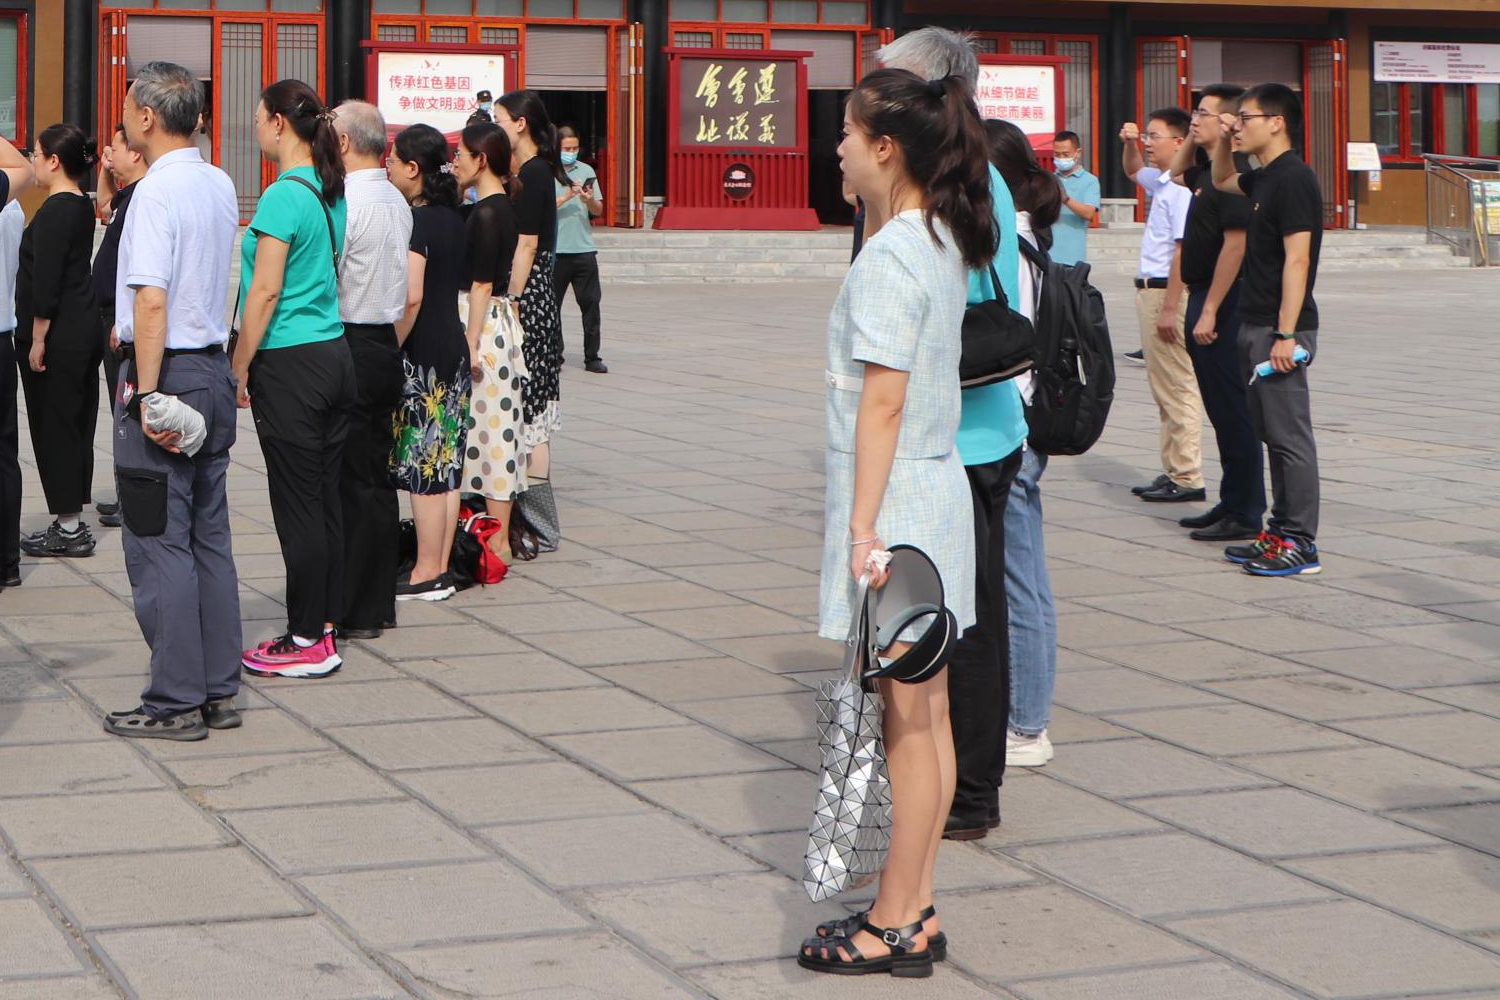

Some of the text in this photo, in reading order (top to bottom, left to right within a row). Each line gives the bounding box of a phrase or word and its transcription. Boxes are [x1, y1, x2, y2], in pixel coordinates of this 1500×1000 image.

[389, 75, 471, 90] 传承红色基因
[975, 86, 1038, 99] 从细节做起
[979, 105, 1044, 119] 因您而美丽
